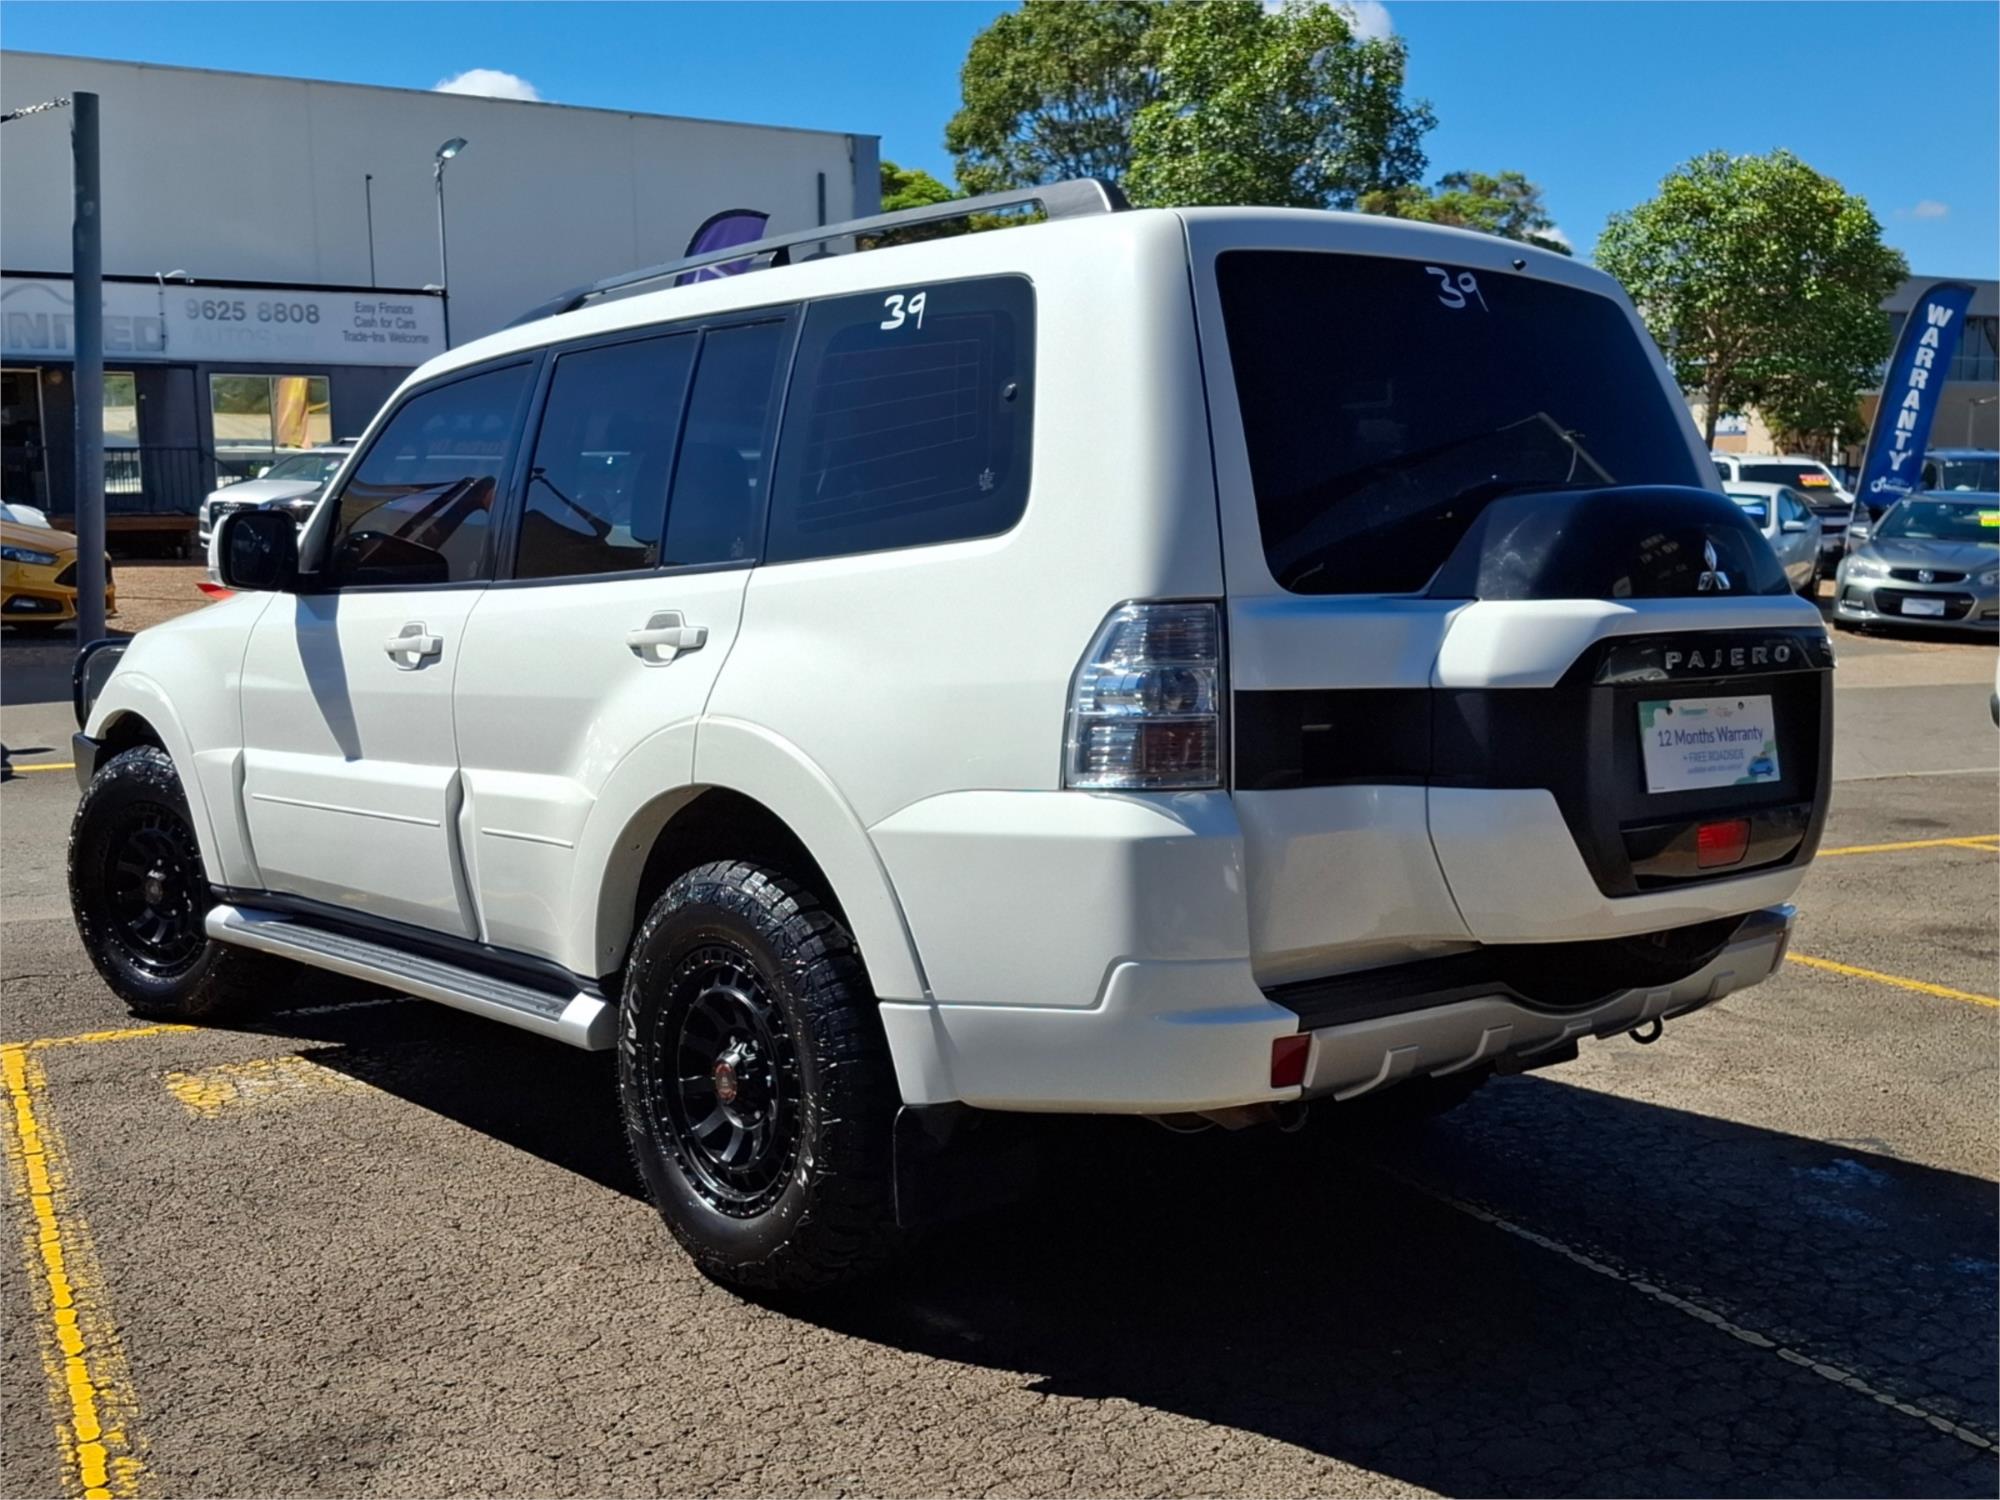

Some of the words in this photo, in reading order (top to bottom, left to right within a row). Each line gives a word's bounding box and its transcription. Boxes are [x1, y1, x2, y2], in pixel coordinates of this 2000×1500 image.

[1425, 266, 1489, 312] 39
[186, 299, 247, 322] 9625
[257, 302, 321, 325] 8808
[354, 301, 376, 315] Easy
[379, 302, 414, 315] Finance
[880, 291, 926, 330] 39
[354, 316, 378, 328] Cash
[380, 317, 392, 328] for
[395, 317, 417, 329] Cars
[342, 330, 386, 342] Trade-Ins
[387, 331, 430, 344] Welcome
[1888, 303, 1952, 472] WARRANTY
[1664, 645, 1791, 670] PAJERO
[1658, 729, 1673, 747] 12
[1674, 727, 1715, 745] Months
[1716, 725, 1763, 743] Warranty
